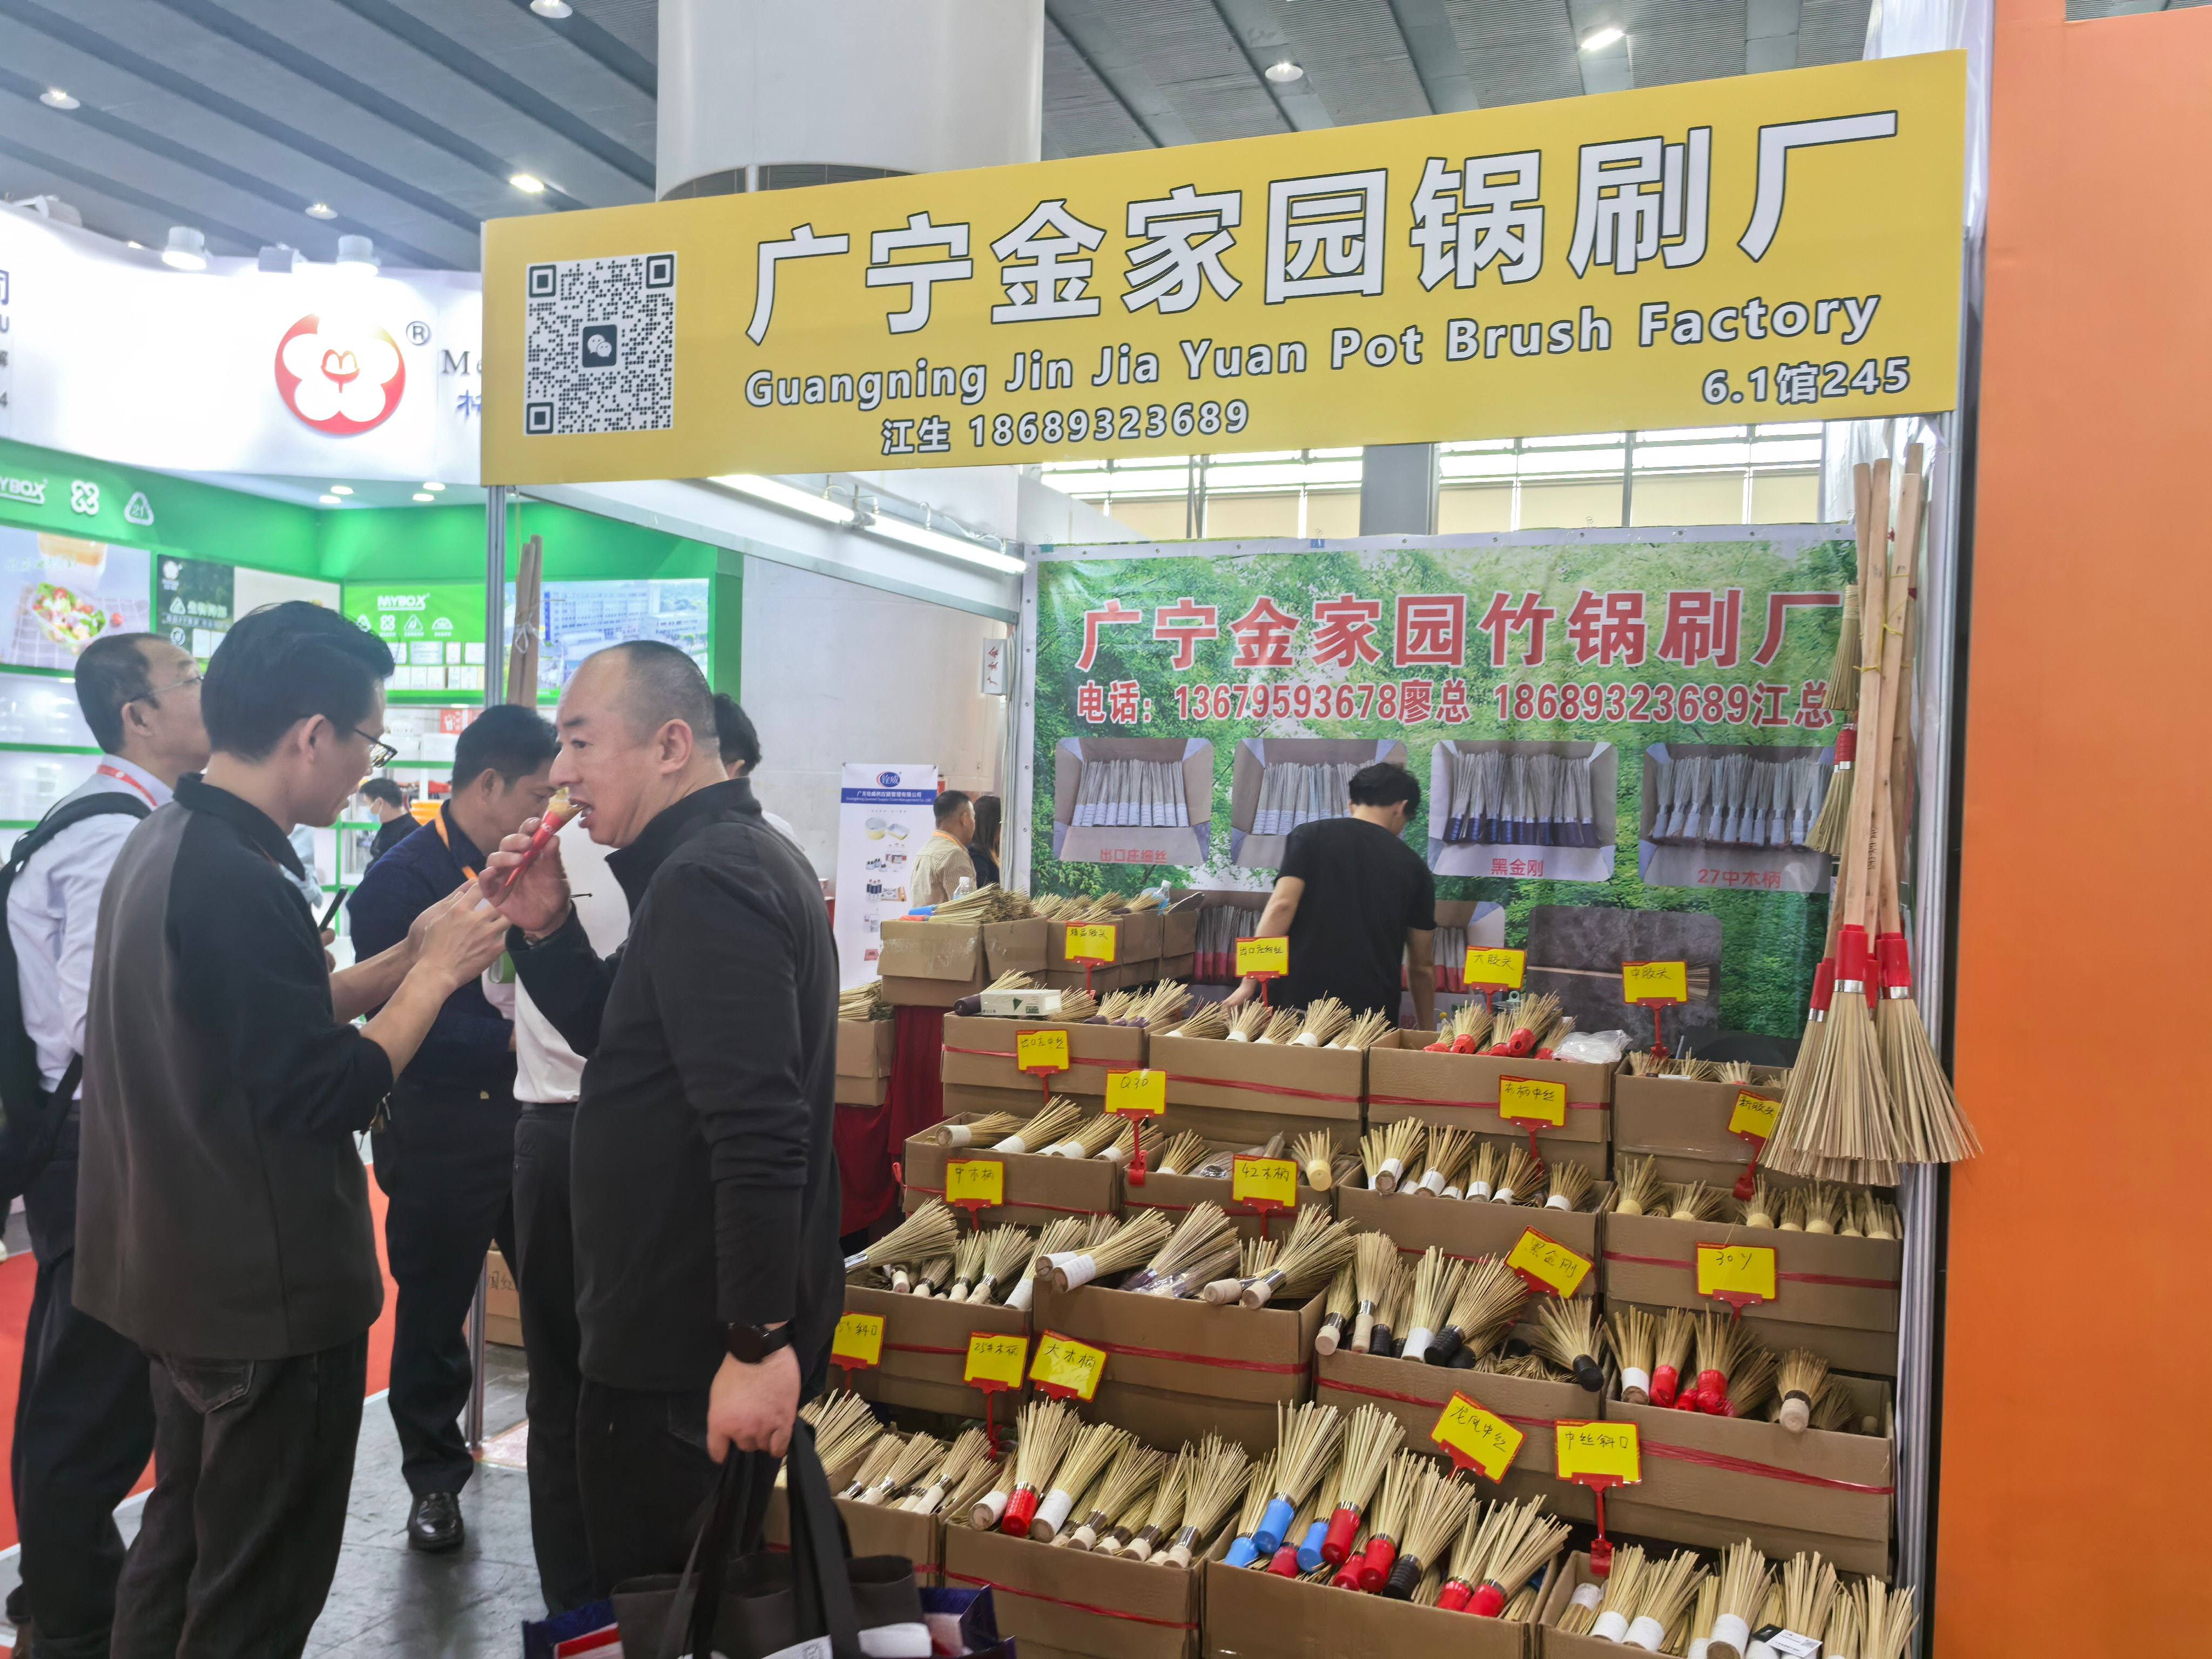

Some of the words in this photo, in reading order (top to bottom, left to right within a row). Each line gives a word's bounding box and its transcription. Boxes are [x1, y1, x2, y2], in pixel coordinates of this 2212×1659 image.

[745, 109, 1898, 346] 广宁金家园锅刷厂
[745, 358, 987, 412] Guangning
[1004, 349, 1074, 392] Jin
[1092, 343, 1159, 387] Jia
[1180, 338, 1307, 379] Yuan
[1331, 325, 1423, 370] Pot
[1446, 306, 1611, 361] Brush
[1638, 294, 1881, 345] Factory
[1702, 356, 1911, 406] 6.1馆245
[881, 415, 950, 456] 江生
[969, 399, 1250, 447] 18689323689
[0, 477, 46, 504] YBOX
[1075, 588, 1844, 672] 广宁金家园竹锅刷厂
[1494, 679, 1833, 730] 18689323689江总
[1491, 858, 1545, 878] 黑金刚
[1697, 868, 1781, 890] 27中木柄
